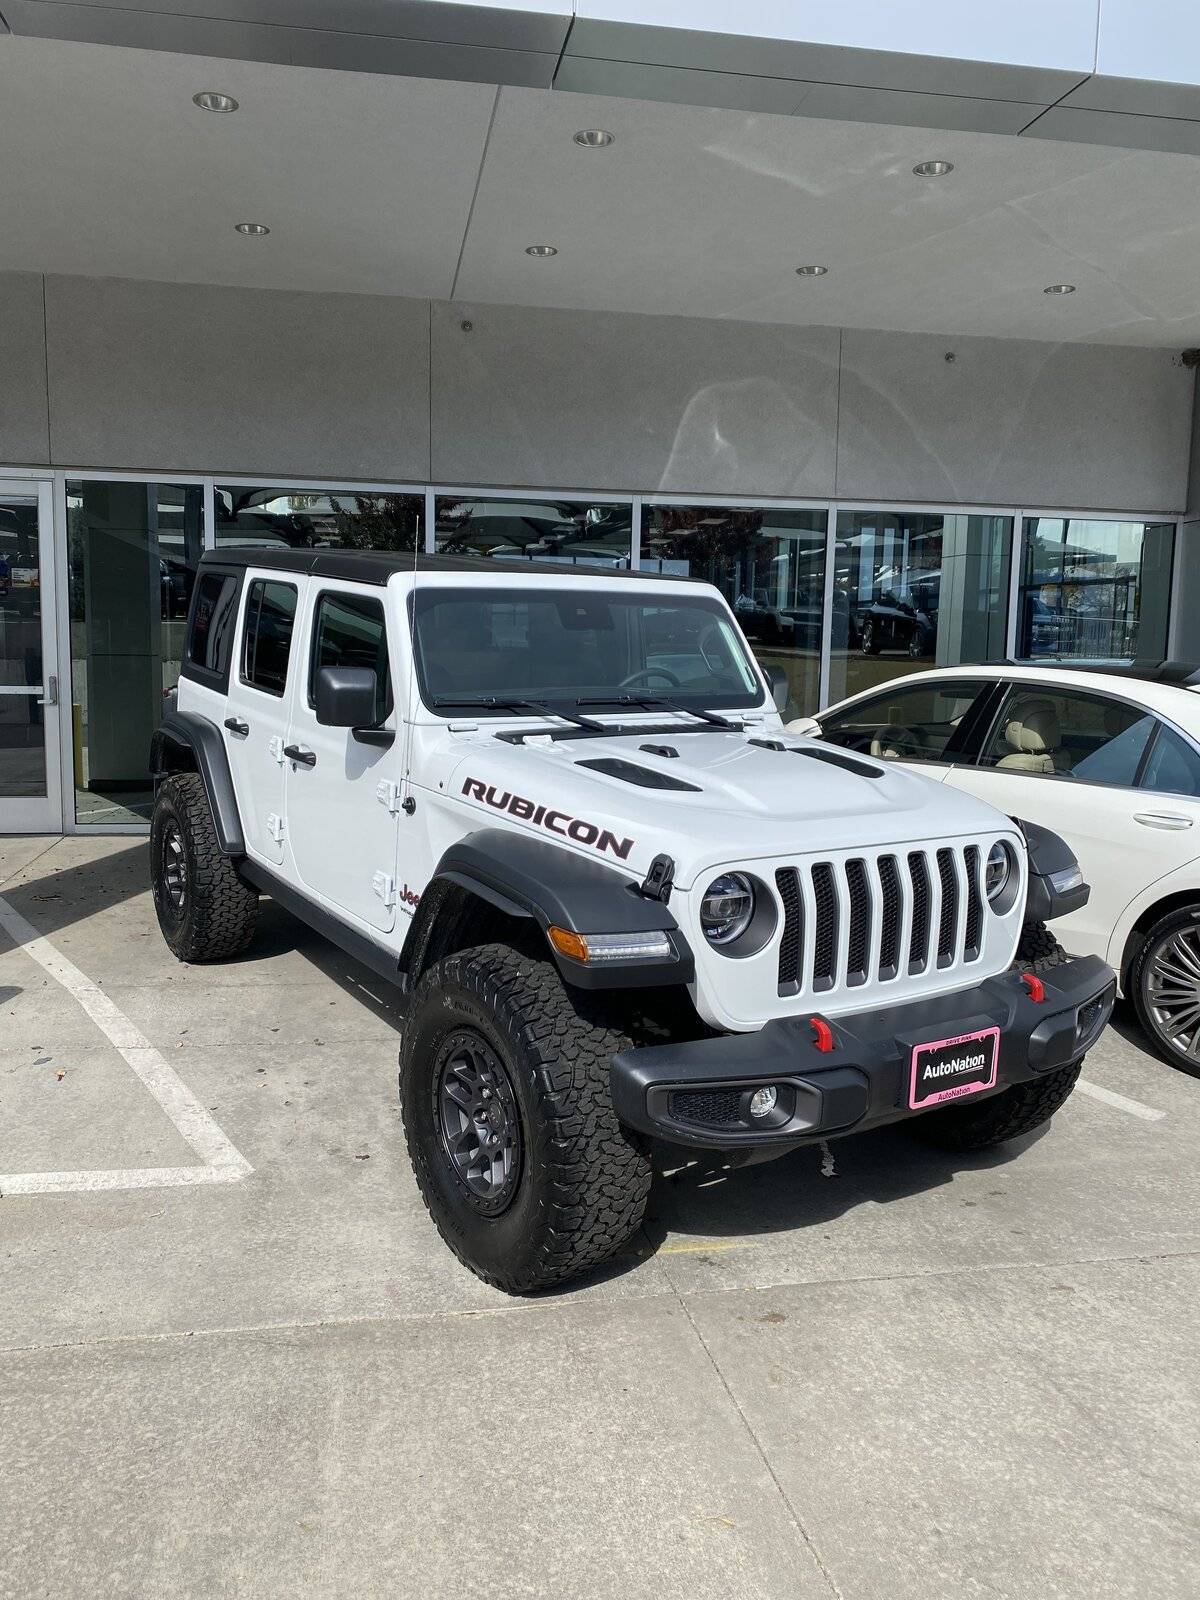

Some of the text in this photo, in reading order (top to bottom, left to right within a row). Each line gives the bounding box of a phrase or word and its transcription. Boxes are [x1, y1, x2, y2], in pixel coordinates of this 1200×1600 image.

[461, 777, 635, 860] RUBICON
[400, 883, 420, 907] Jee
[923, 1054, 985, 1080] AutoNation
[938, 1087, 970, 1101] AutoNation
